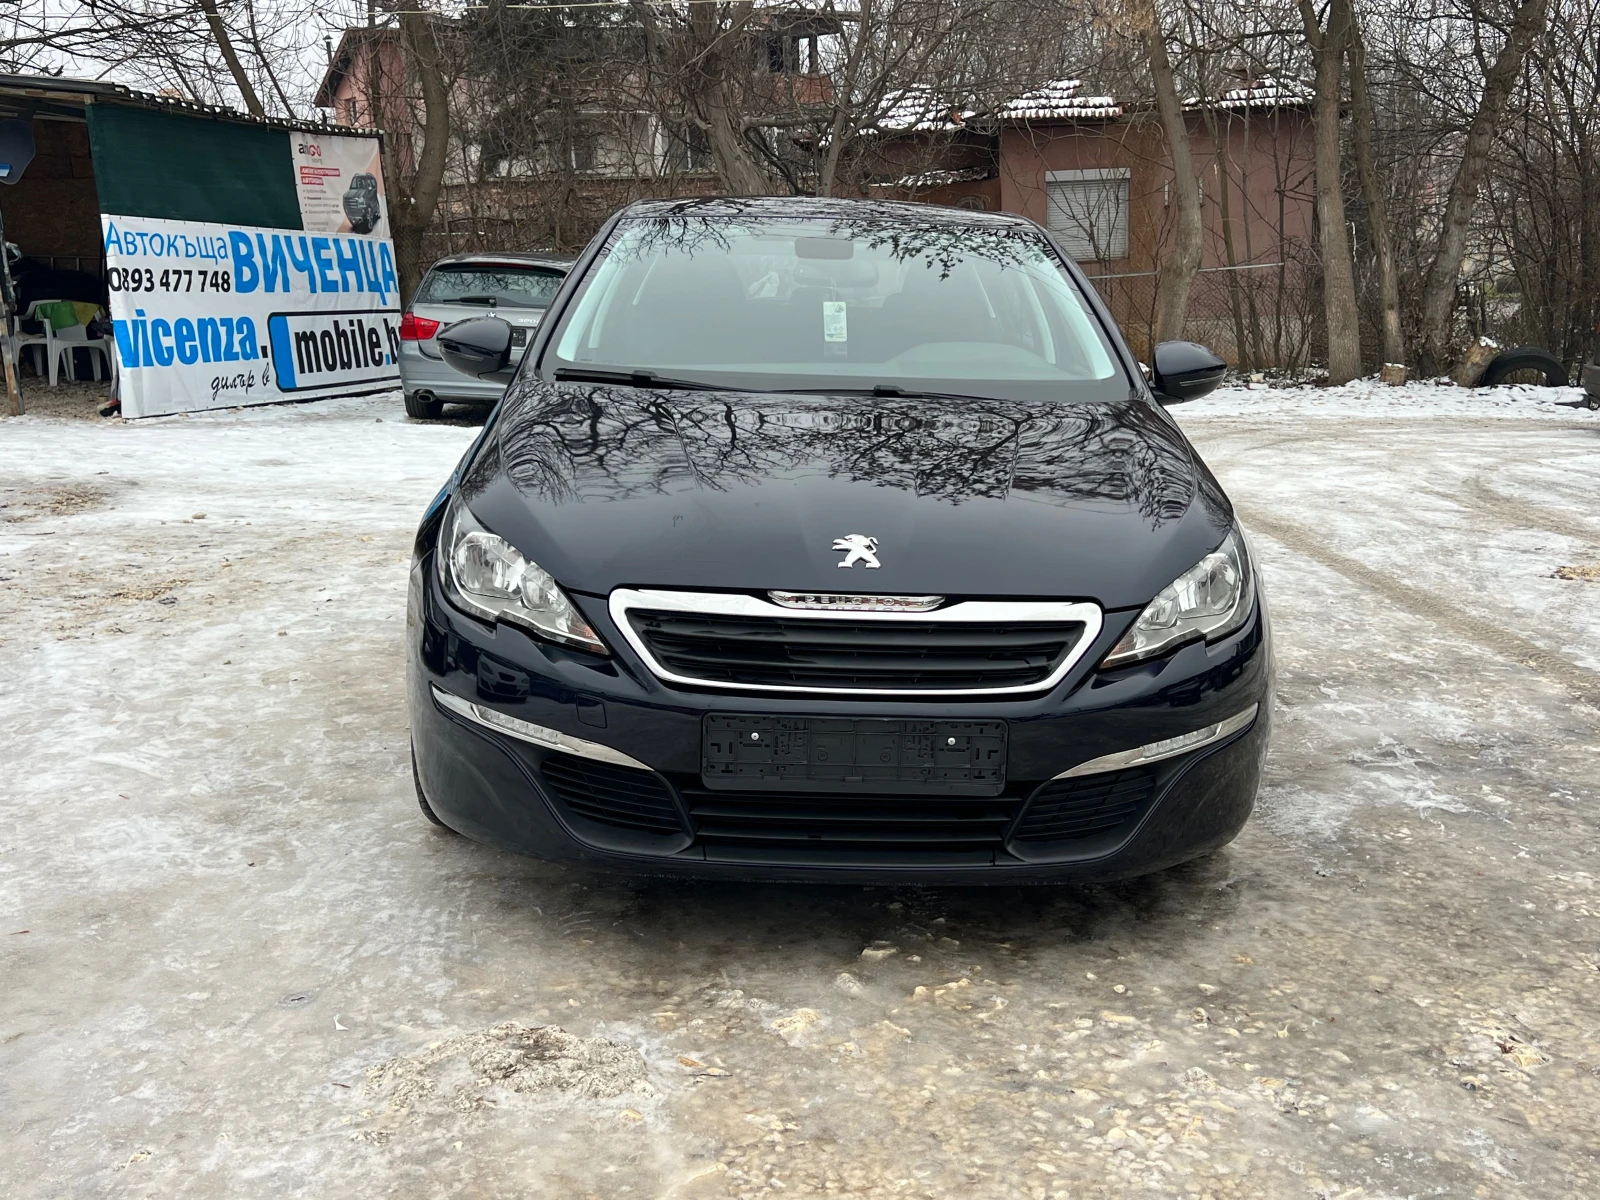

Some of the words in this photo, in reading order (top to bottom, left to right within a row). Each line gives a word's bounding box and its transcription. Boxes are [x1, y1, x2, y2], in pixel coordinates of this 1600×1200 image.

[105, 221, 229, 265] Автокъща
[228, 231, 399, 306] ВИЧЕНЦА
[108, 267, 155, 292] 0893
[159, 269, 193, 292] 477
[199, 271, 232, 292] 748
[294, 317, 401, 374] mobile.b
[210, 366, 257, 400] дилър
